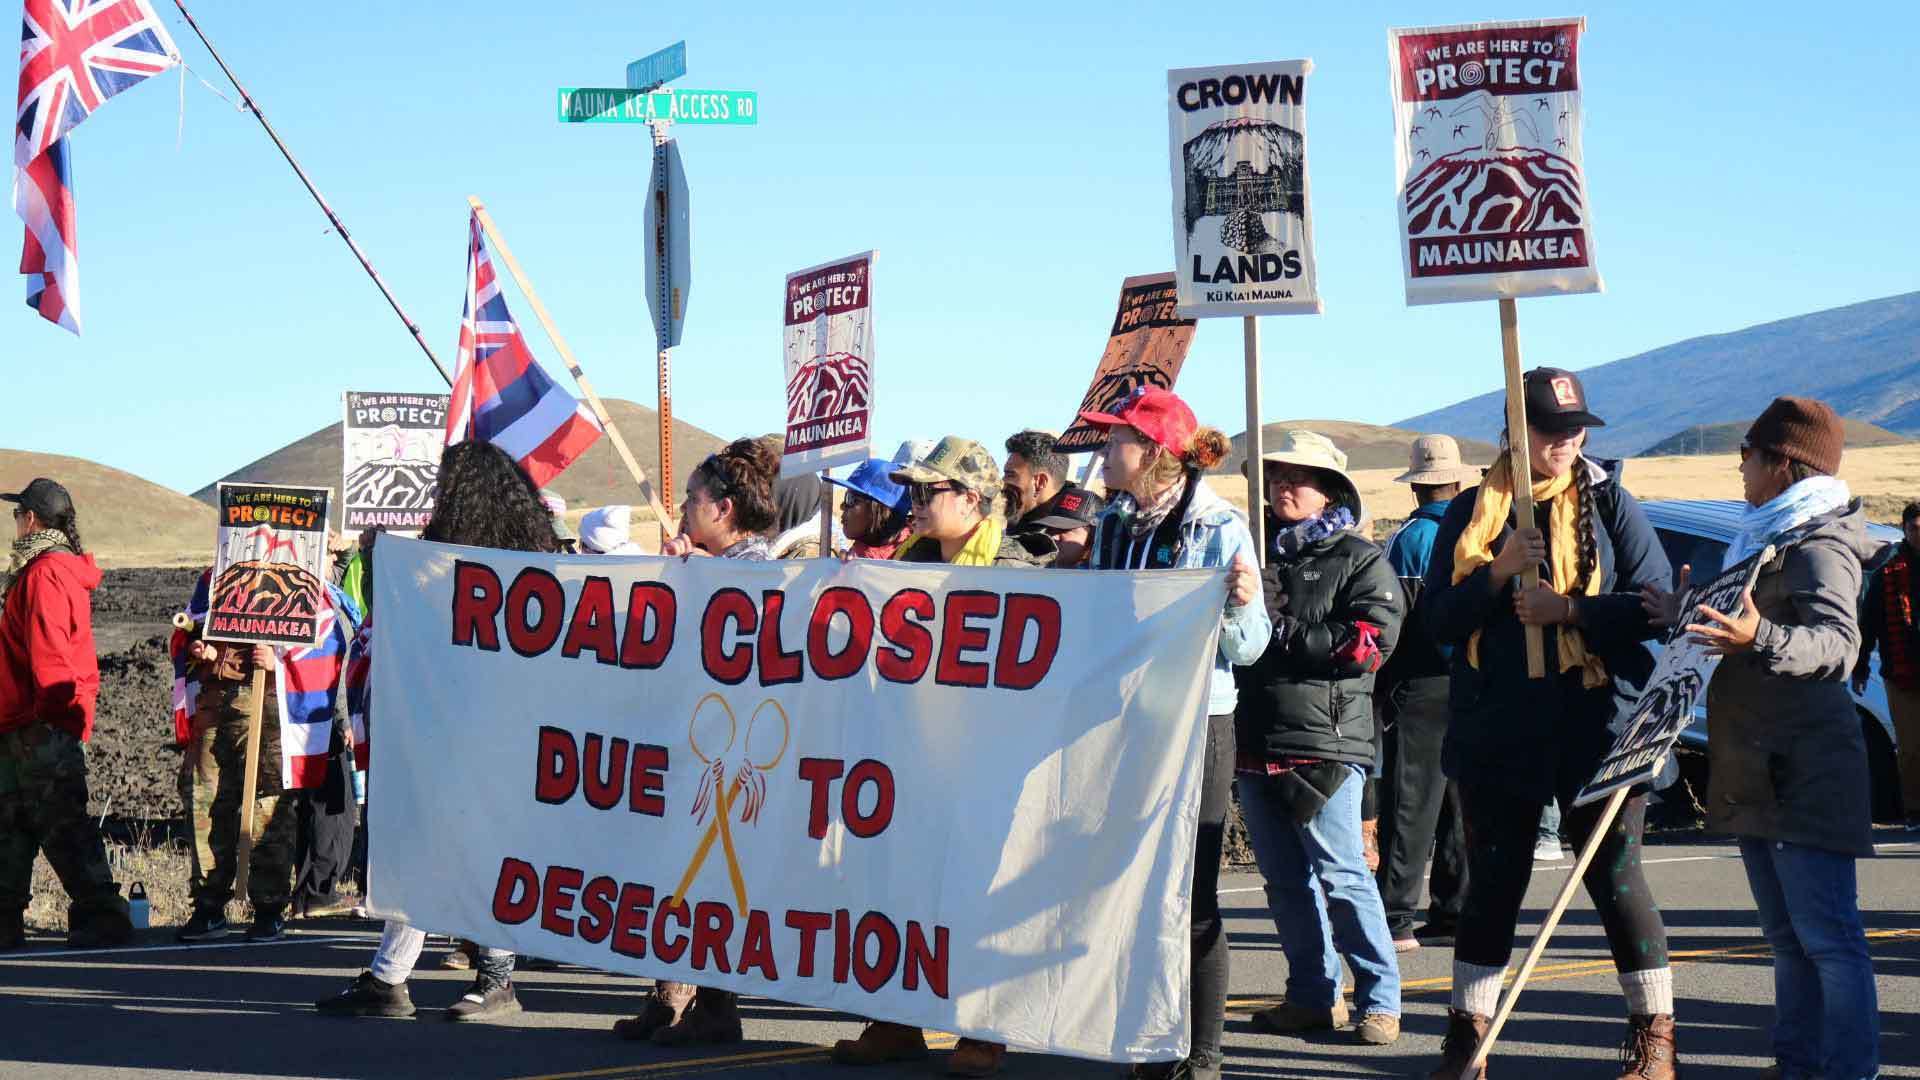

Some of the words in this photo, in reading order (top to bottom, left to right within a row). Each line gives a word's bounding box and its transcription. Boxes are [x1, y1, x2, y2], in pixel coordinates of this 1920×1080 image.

[1426, 46, 1450, 62] WE
[1455, 40, 1485, 56] ARE
[1490, 40, 1529, 53] HERE
[1532, 41, 1553, 55] TO
[1415, 58, 1565, 95] PROTECT
[561, 92, 617, 118] MAUNA
[625, 92, 656, 118] KEA
[670, 94, 729, 119] ACCESS
[737, 99, 753, 117] RD
[1176, 74, 1304, 112] CROWN
[1418, 237, 1580, 268] MAUNAKEA
[1193, 250, 1302, 284] LANDS
[799, 282, 811, 295] WE
[812, 277, 826, 289] ARE
[827, 273, 846, 284] HERE
[847, 273, 857, 282] TO
[1252, 289, 1293, 300] MAUNA
[793, 286, 861, 320] PROTECT
[361, 397, 377, 407] WE
[379, 396, 398, 405] ARE
[400, 396, 424, 406] HERE
[426, 398, 438, 408] TO
[356, 407, 444, 426] PROTECT
[787, 416, 863, 447] MAUNAKEA
[236, 494, 251, 504] WE
[253, 493, 272, 503] ARE
[273, 493, 297, 505] HERE
[299, 497, 311, 507] TO
[228, 504, 318, 528] PROTECT
[350, 511, 433, 526] MAUNAK
[212, 616, 312, 637] MAUNAKEA
[453, 559, 677, 669] ROAD
[700, 586, 1061, 691] CLOSED
[534, 725, 669, 817] DUE
[798, 756, 896, 840] TO
[491, 856, 950, 999] DESECRATION
